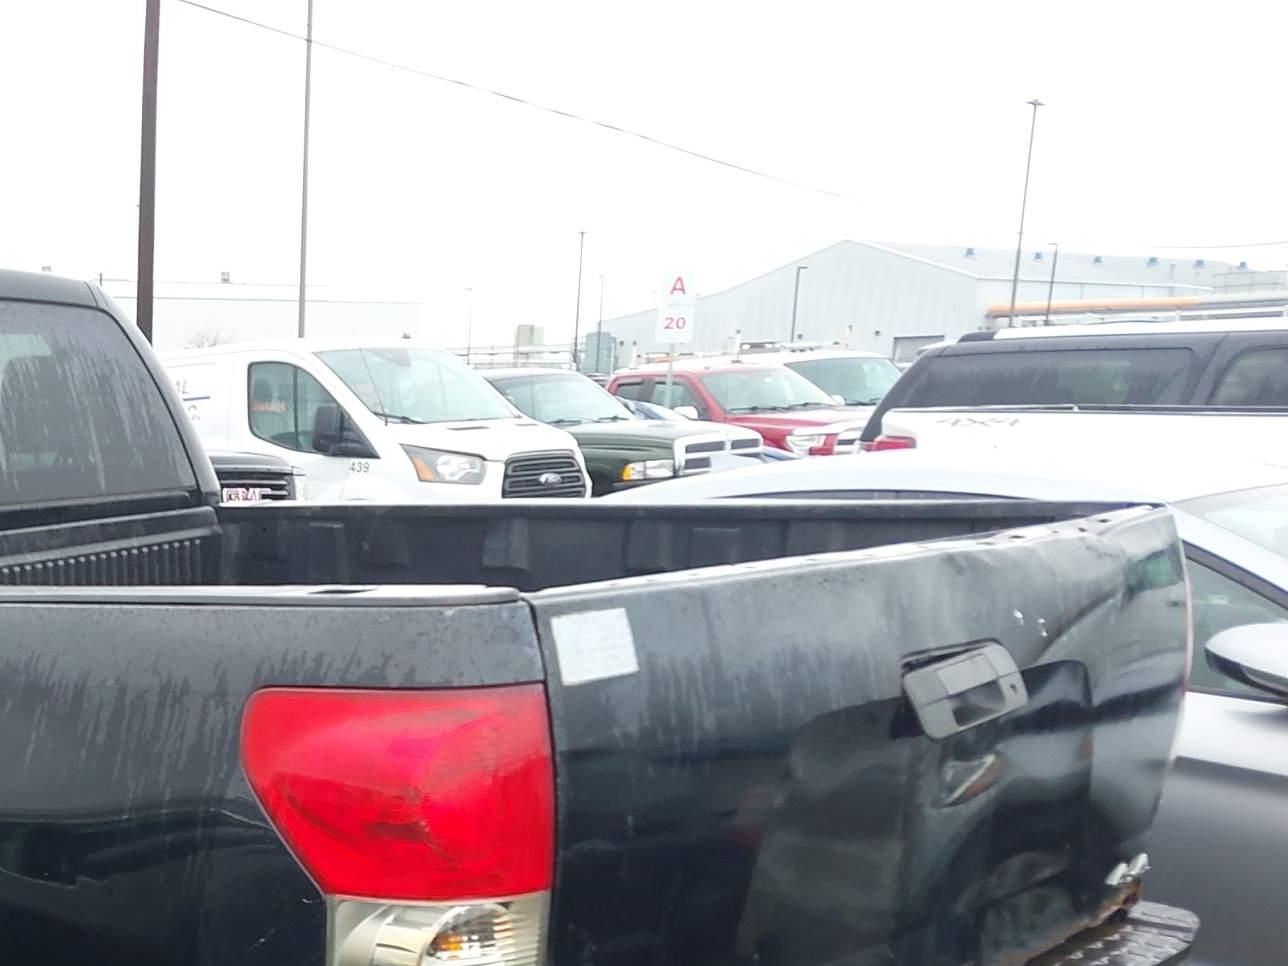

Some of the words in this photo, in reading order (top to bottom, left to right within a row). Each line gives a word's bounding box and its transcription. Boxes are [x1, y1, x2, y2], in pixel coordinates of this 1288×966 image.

[670, 276, 686, 295] A
[663, 316, 686, 330] 20
[349, 461, 371, 474] 439
